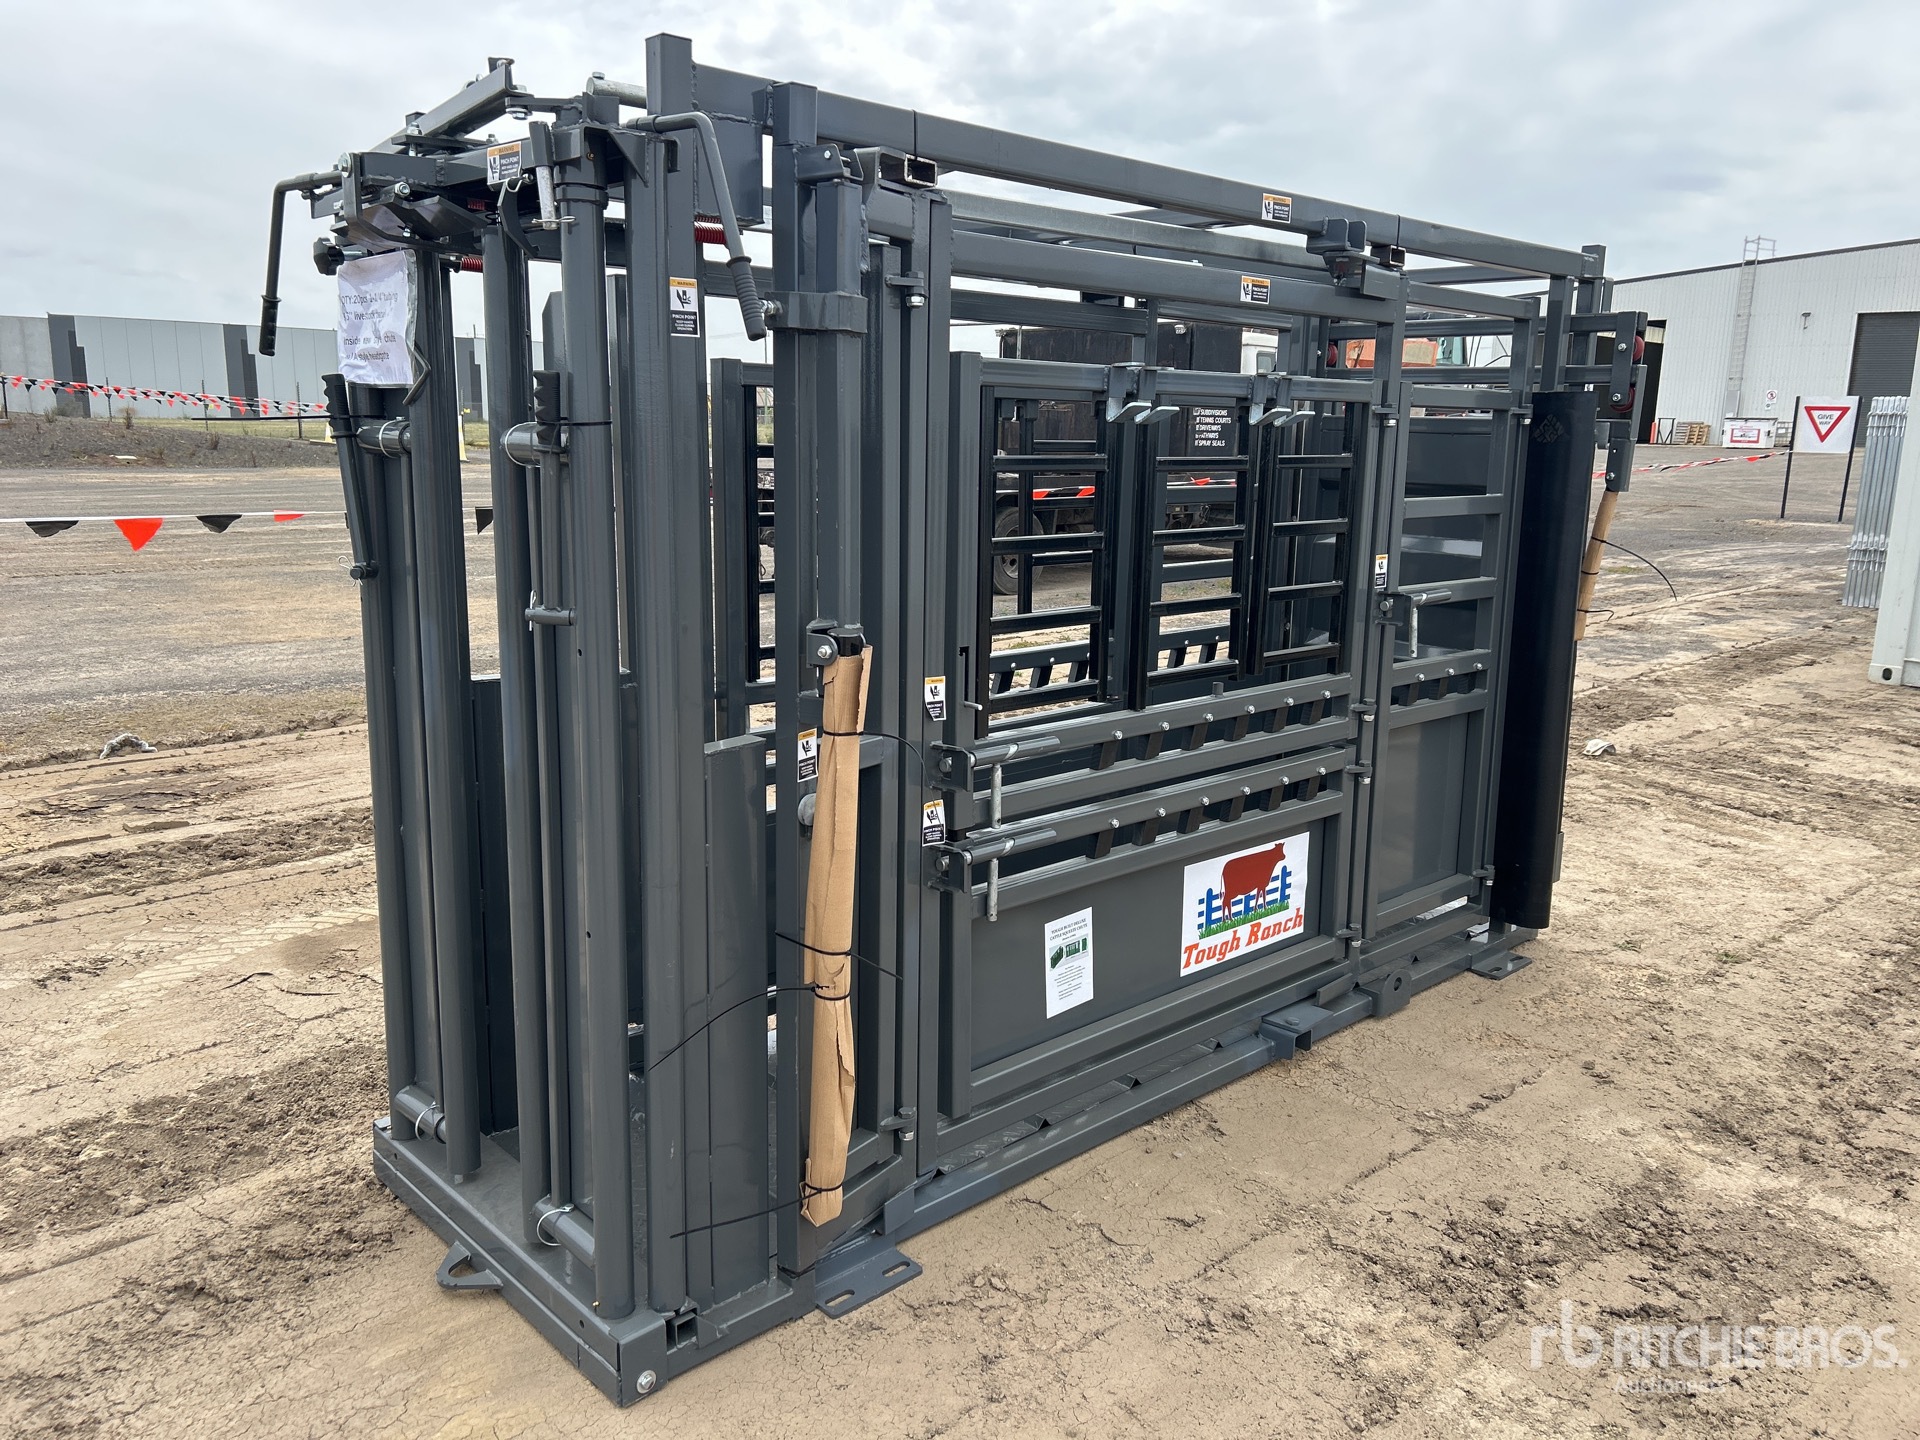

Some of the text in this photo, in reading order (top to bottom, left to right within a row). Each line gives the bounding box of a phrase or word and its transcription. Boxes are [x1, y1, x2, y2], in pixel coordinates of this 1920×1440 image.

[344, 336, 360, 346] inside
[384, 334, 396, 342] chute
[1182, 907, 1303, 969] Tough Ranch
